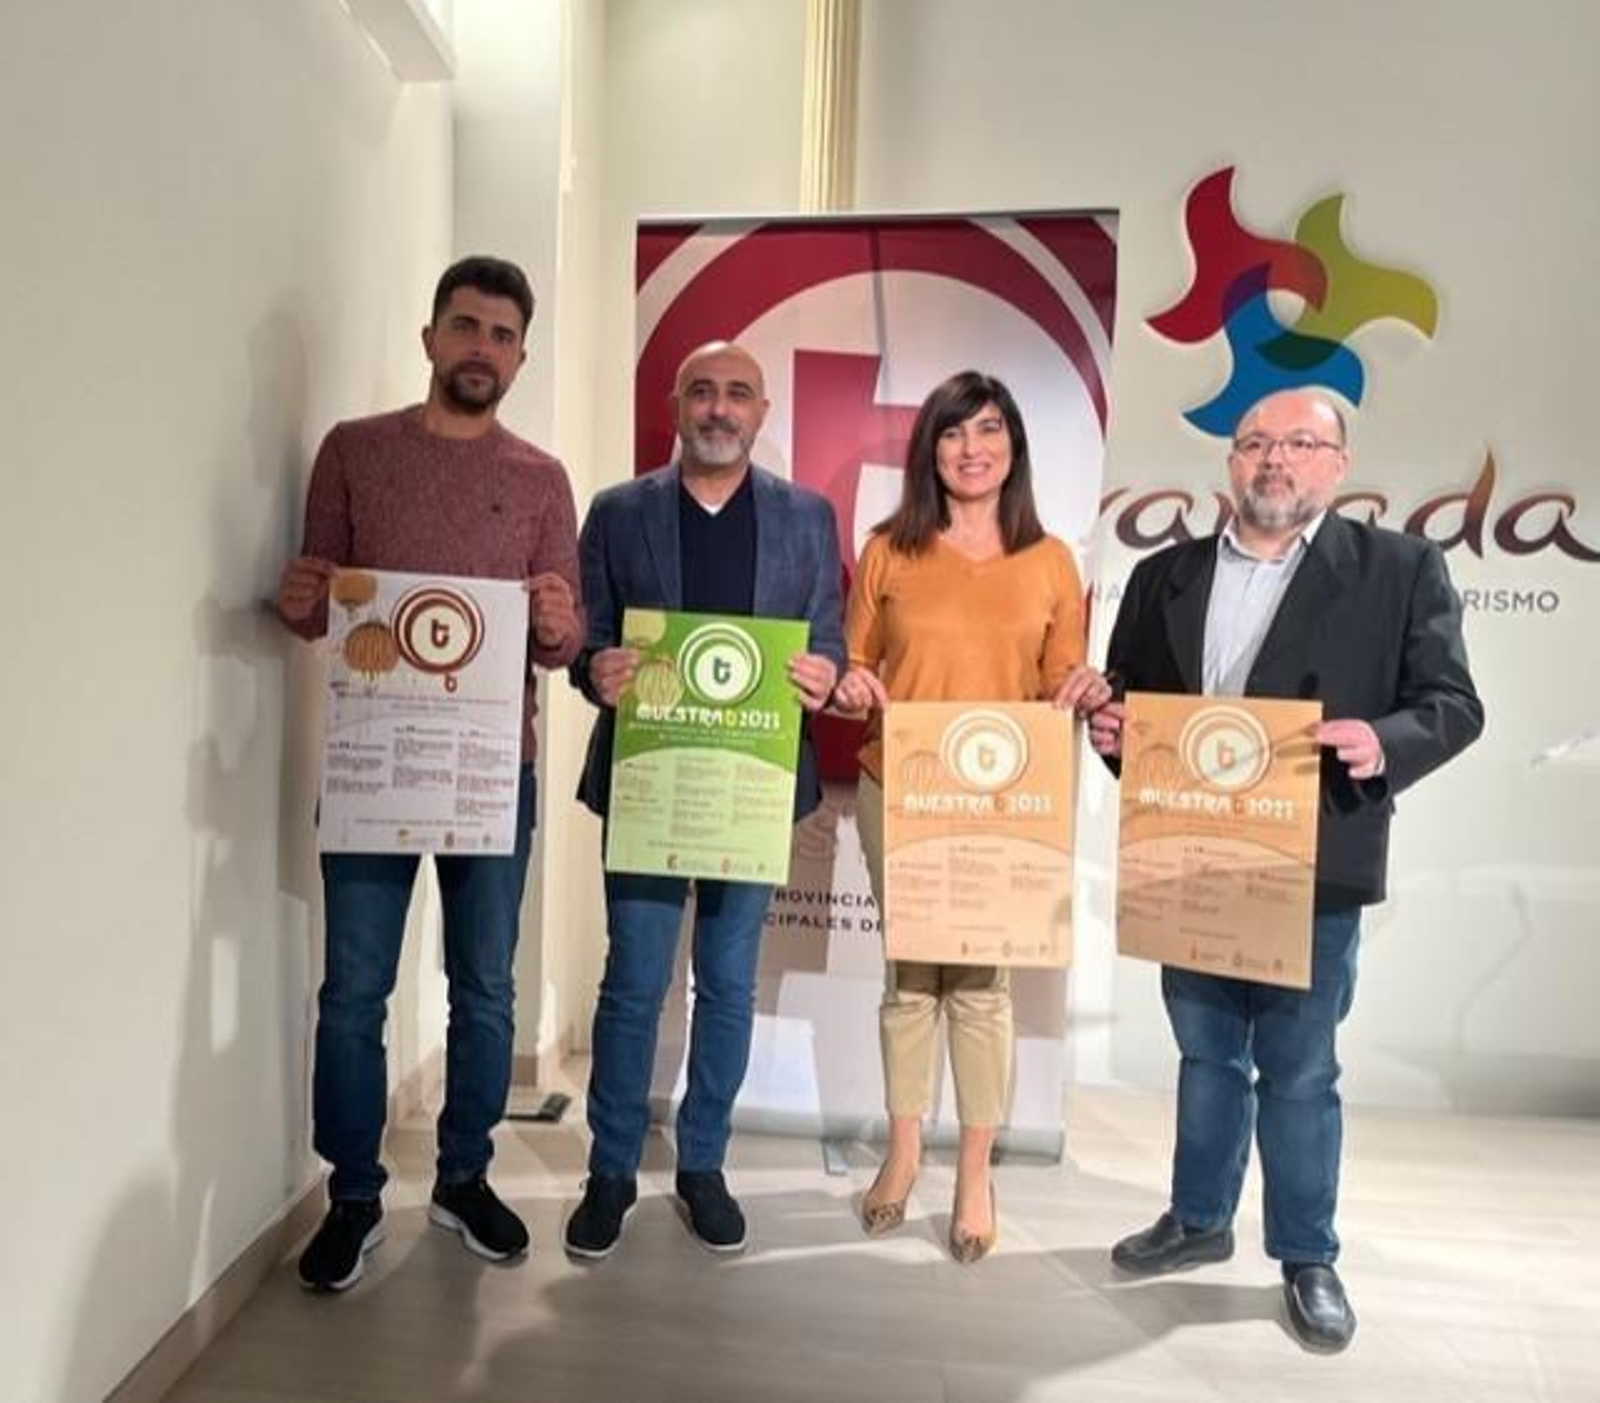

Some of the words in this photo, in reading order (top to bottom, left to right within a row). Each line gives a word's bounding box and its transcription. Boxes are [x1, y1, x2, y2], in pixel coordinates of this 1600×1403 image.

[1464, 589, 1561, 613] RISMO
[774, 889, 876, 909] ROVINCIA
[762, 912, 853, 931] CIPALES
